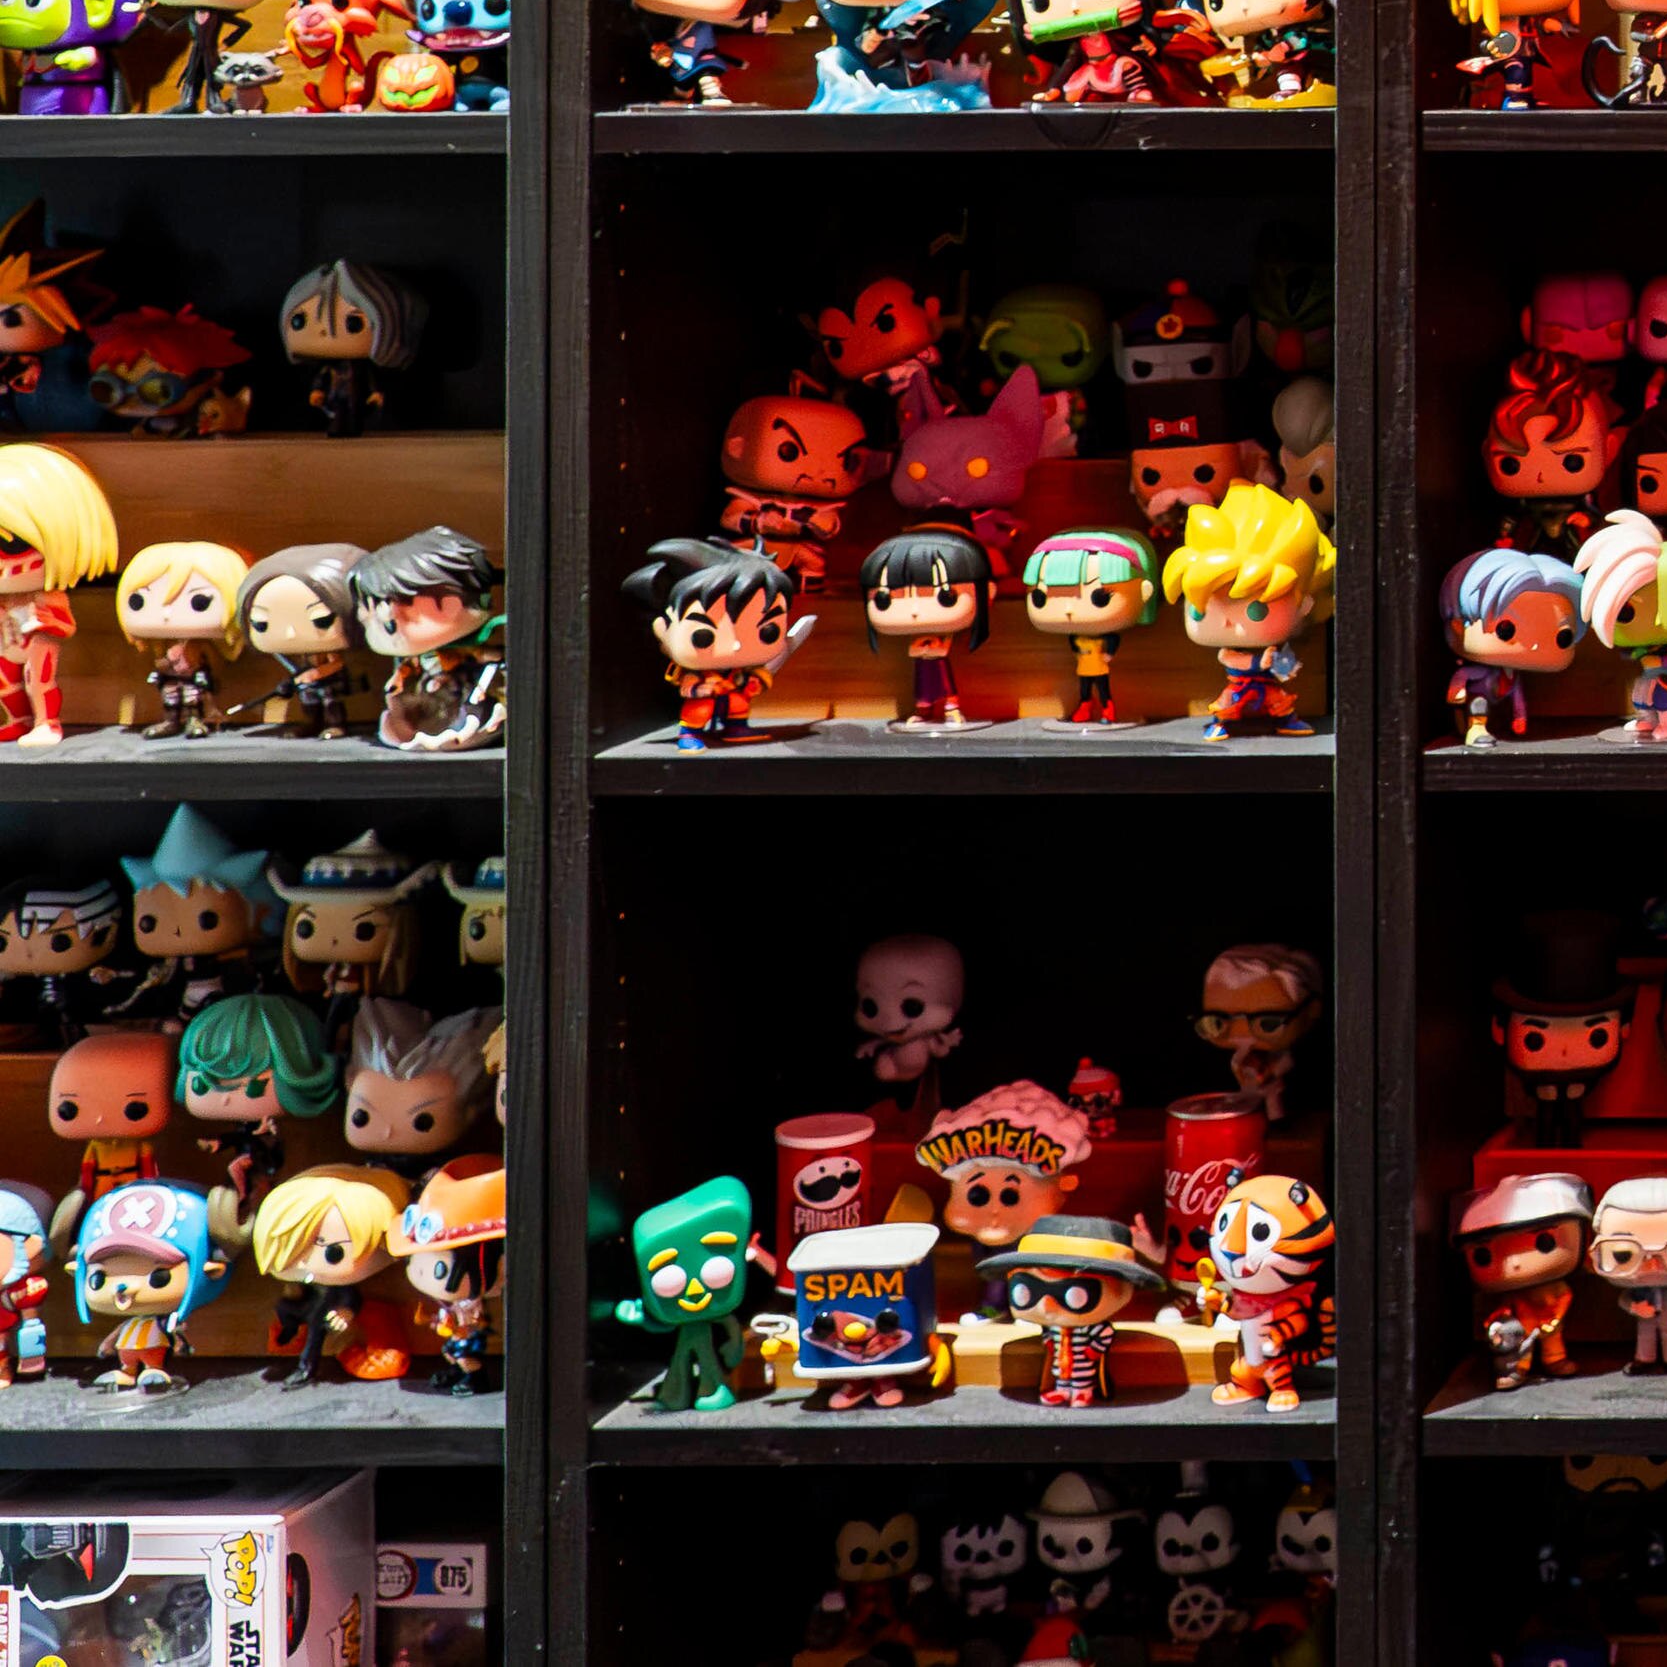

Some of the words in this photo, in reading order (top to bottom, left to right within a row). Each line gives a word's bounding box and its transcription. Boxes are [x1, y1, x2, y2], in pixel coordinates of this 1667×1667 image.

[919, 1119, 1066, 1176] WARHEADS
[793, 1200, 861, 1235] PRINGLES
[804, 1269, 905, 1301] SPAM
[221, 1531, 258, 1607] POP!
[245, 1620, 261, 1667] STA
